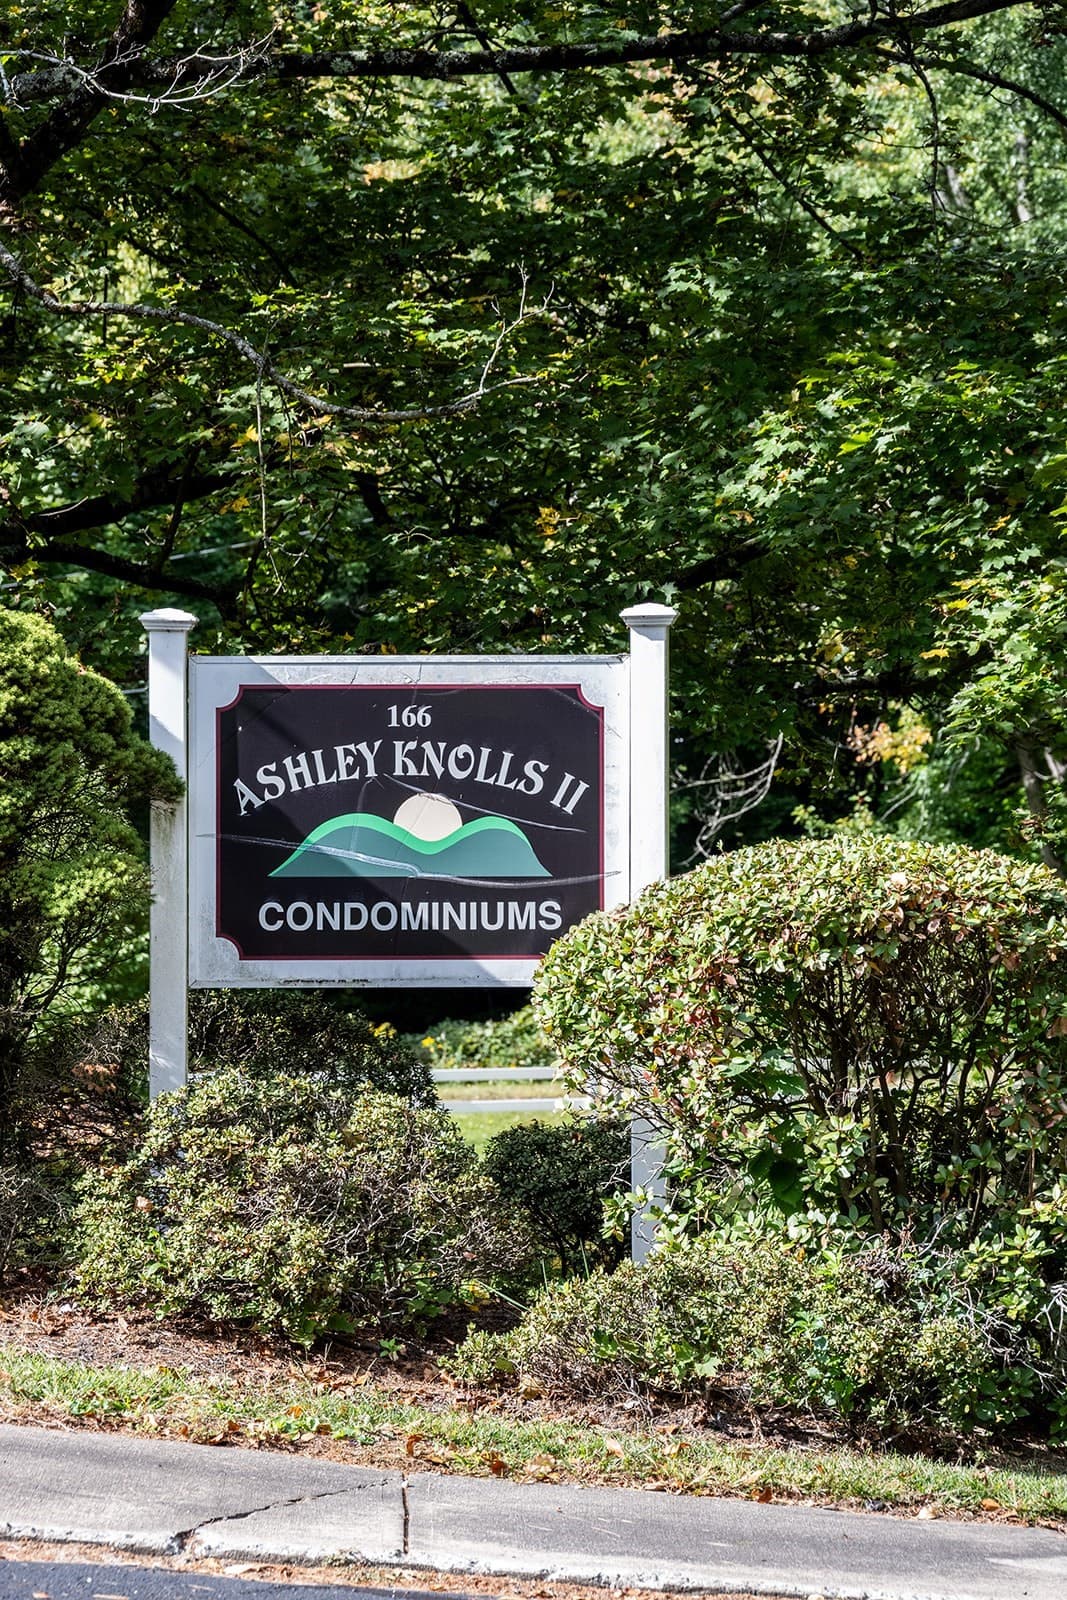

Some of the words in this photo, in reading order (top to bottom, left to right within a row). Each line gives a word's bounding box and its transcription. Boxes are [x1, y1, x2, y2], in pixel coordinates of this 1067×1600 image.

[387, 704, 433, 728] 166
[233, 739, 383, 816] ASHLEY
[392, 740, 550, 795] KNOLLS
[549, 772, 590, 816] II
[258, 901, 563, 931] CONDOMINIUMS
